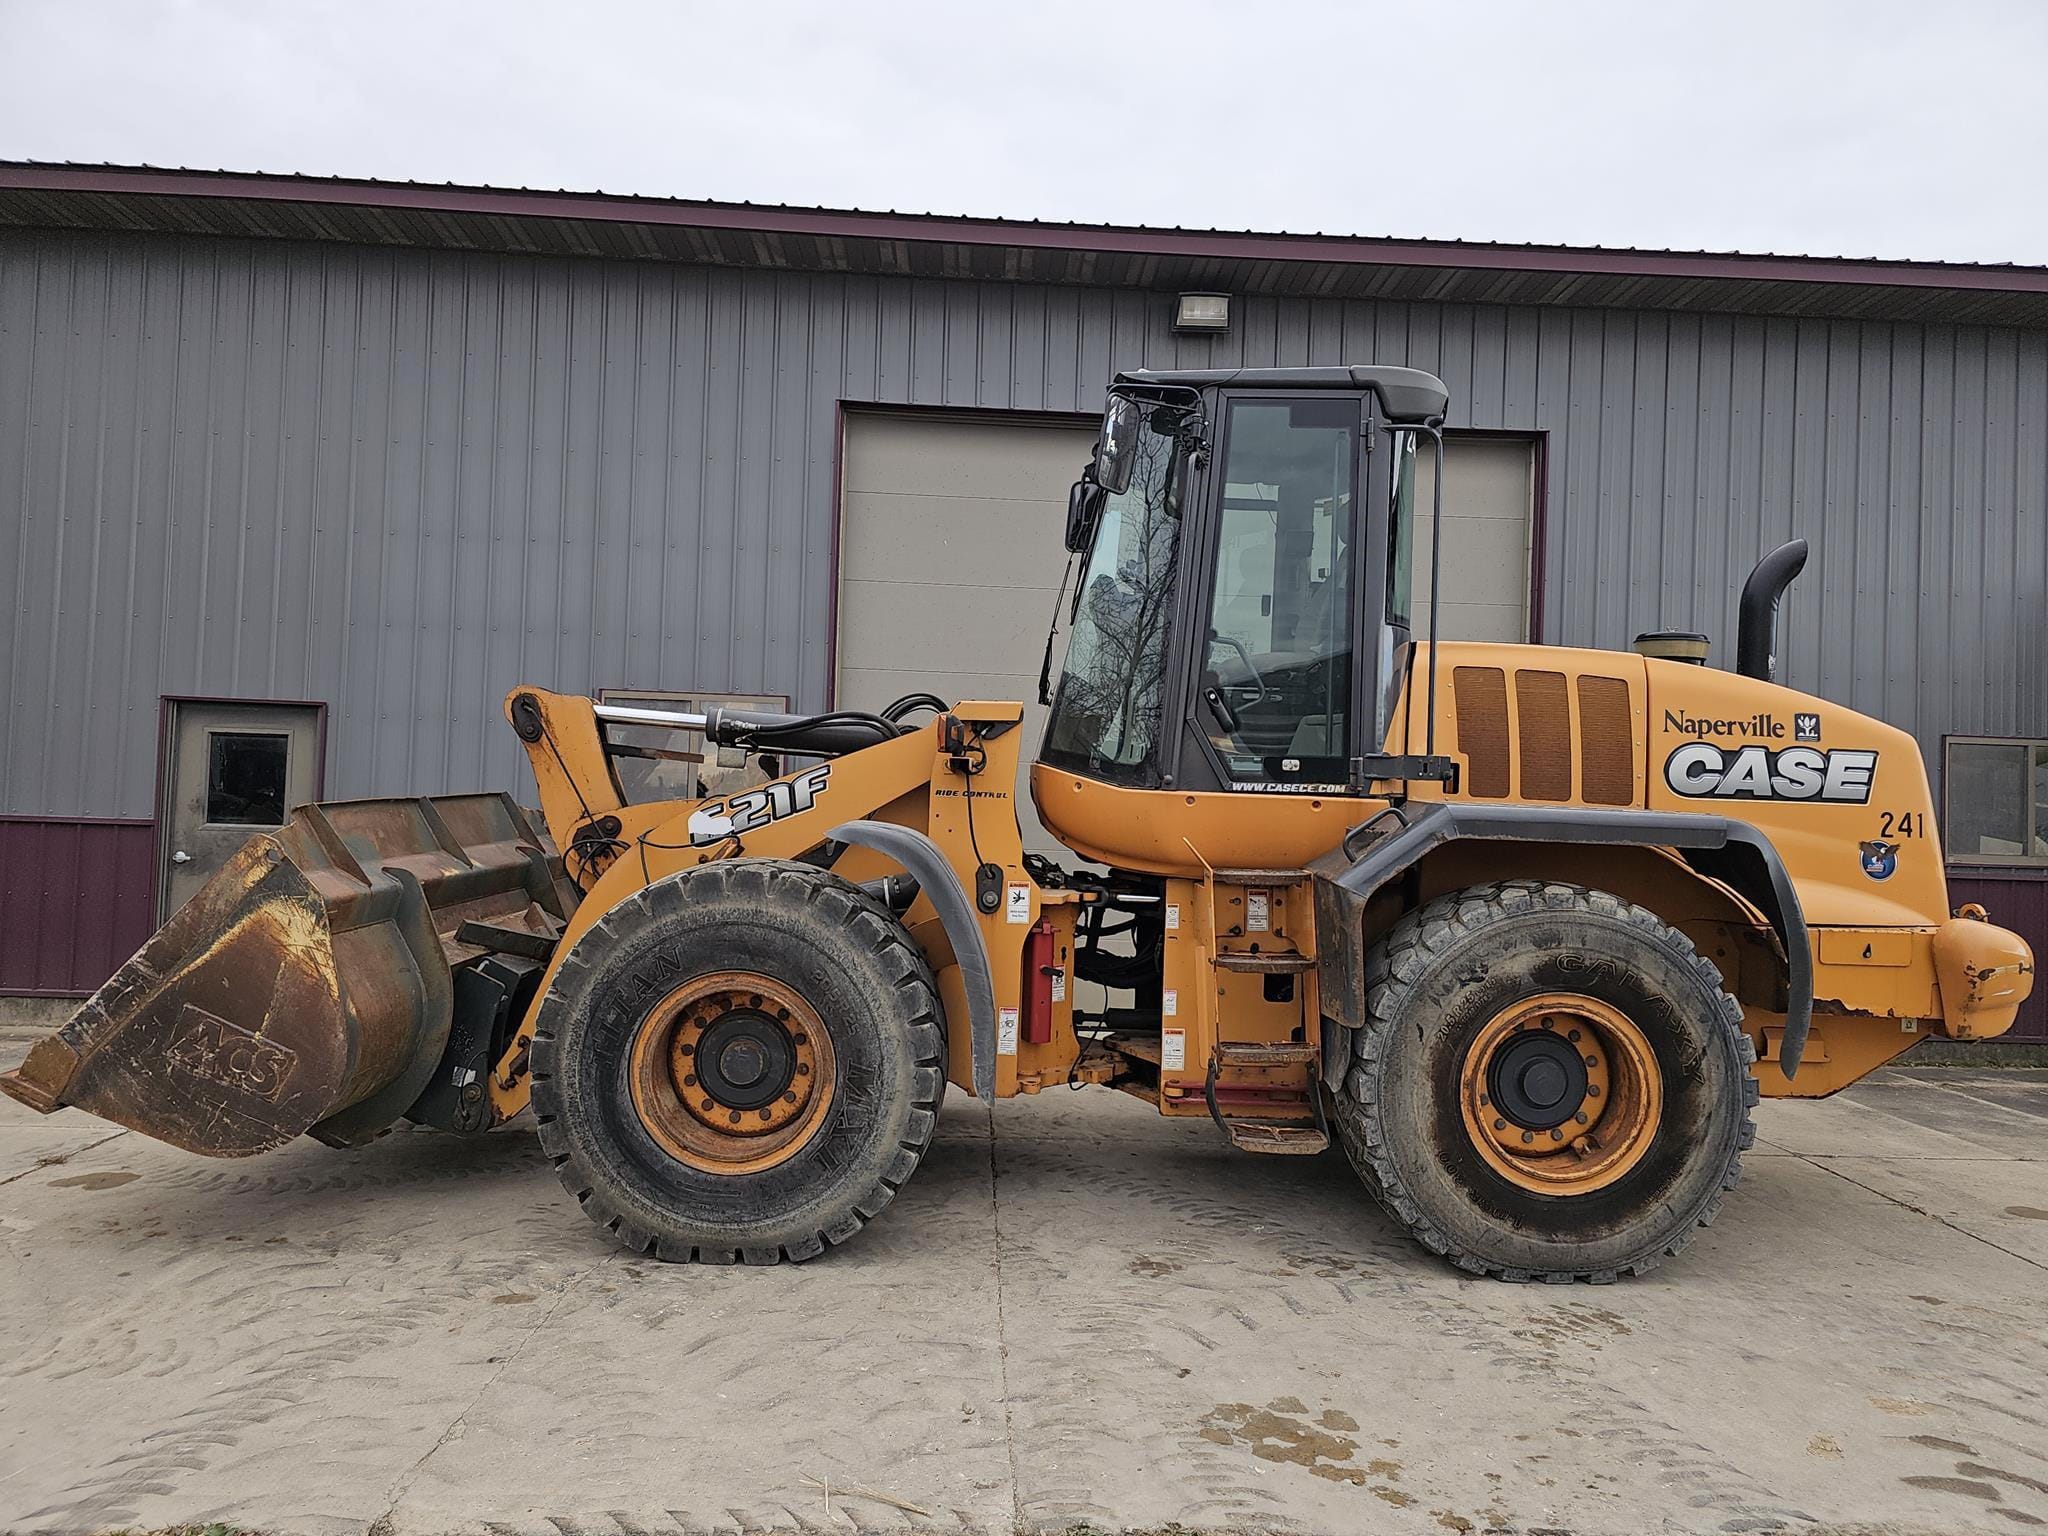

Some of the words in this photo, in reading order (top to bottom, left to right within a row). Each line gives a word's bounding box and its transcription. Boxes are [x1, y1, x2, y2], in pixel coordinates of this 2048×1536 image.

[1663, 709, 1786, 740] Naperville
[1667, 743, 1877, 801] CASE
[935, 789, 960, 797] RIDE
[1231, 782, 1346, 793] WWW.CASECE.COM
[1880, 811, 1923, 839] 241
[1556, 953, 1705, 1085] GALAXY
